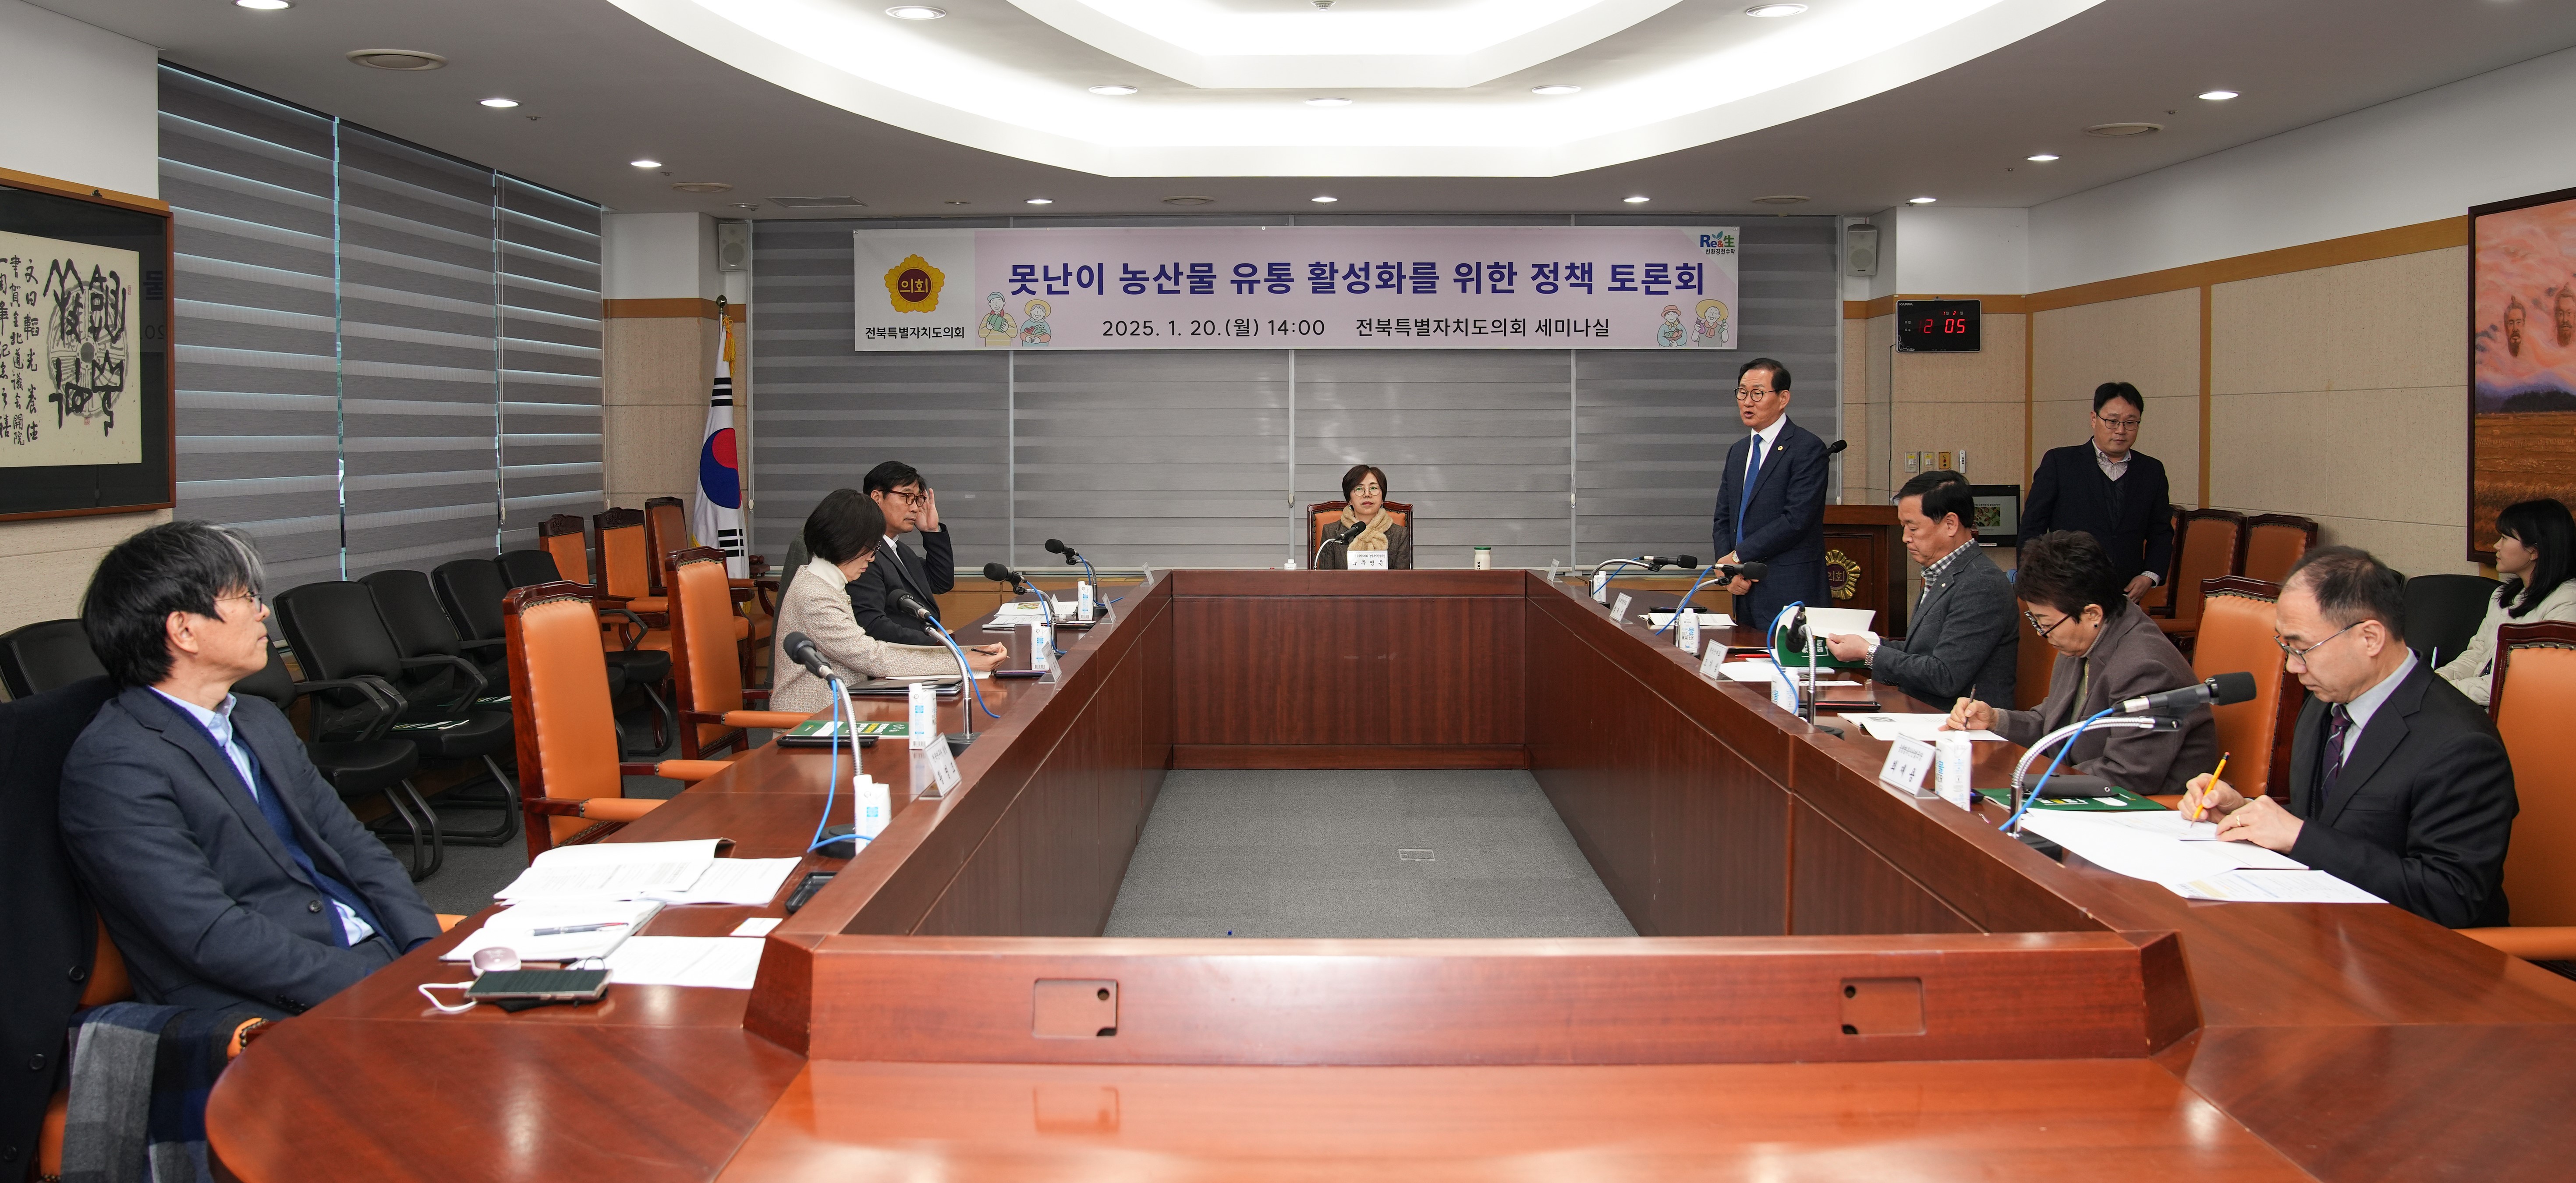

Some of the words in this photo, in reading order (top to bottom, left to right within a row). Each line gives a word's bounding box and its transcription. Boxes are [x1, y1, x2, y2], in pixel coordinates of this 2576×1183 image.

[899, 277, 928, 293] 의회
[1009, 262, 1103, 295] 못난이
[1120, 263, 1217, 295] 농산물
[1230, 263, 1294, 295] 유통
[1308, 262, 1439, 294] 활성화를
[1453, 262, 1517, 294] 위한
[1531, 262, 1592, 295] 정책
[1608, 263, 1703, 295] 토론회
[865, 327, 965, 339] 전북특별자치도의회
[1103, 320, 1159, 336] 2025.
[1169, 320, 1181, 336] 1.
[1191, 319, 1258, 337] 20.(월)
[1269, 320, 1325, 335] 14:00
[1357, 318, 1526, 337] 전북특별자치도의회
[1535, 318, 1609, 337] 세미나실
[1945, 319, 1966, 334] 05
